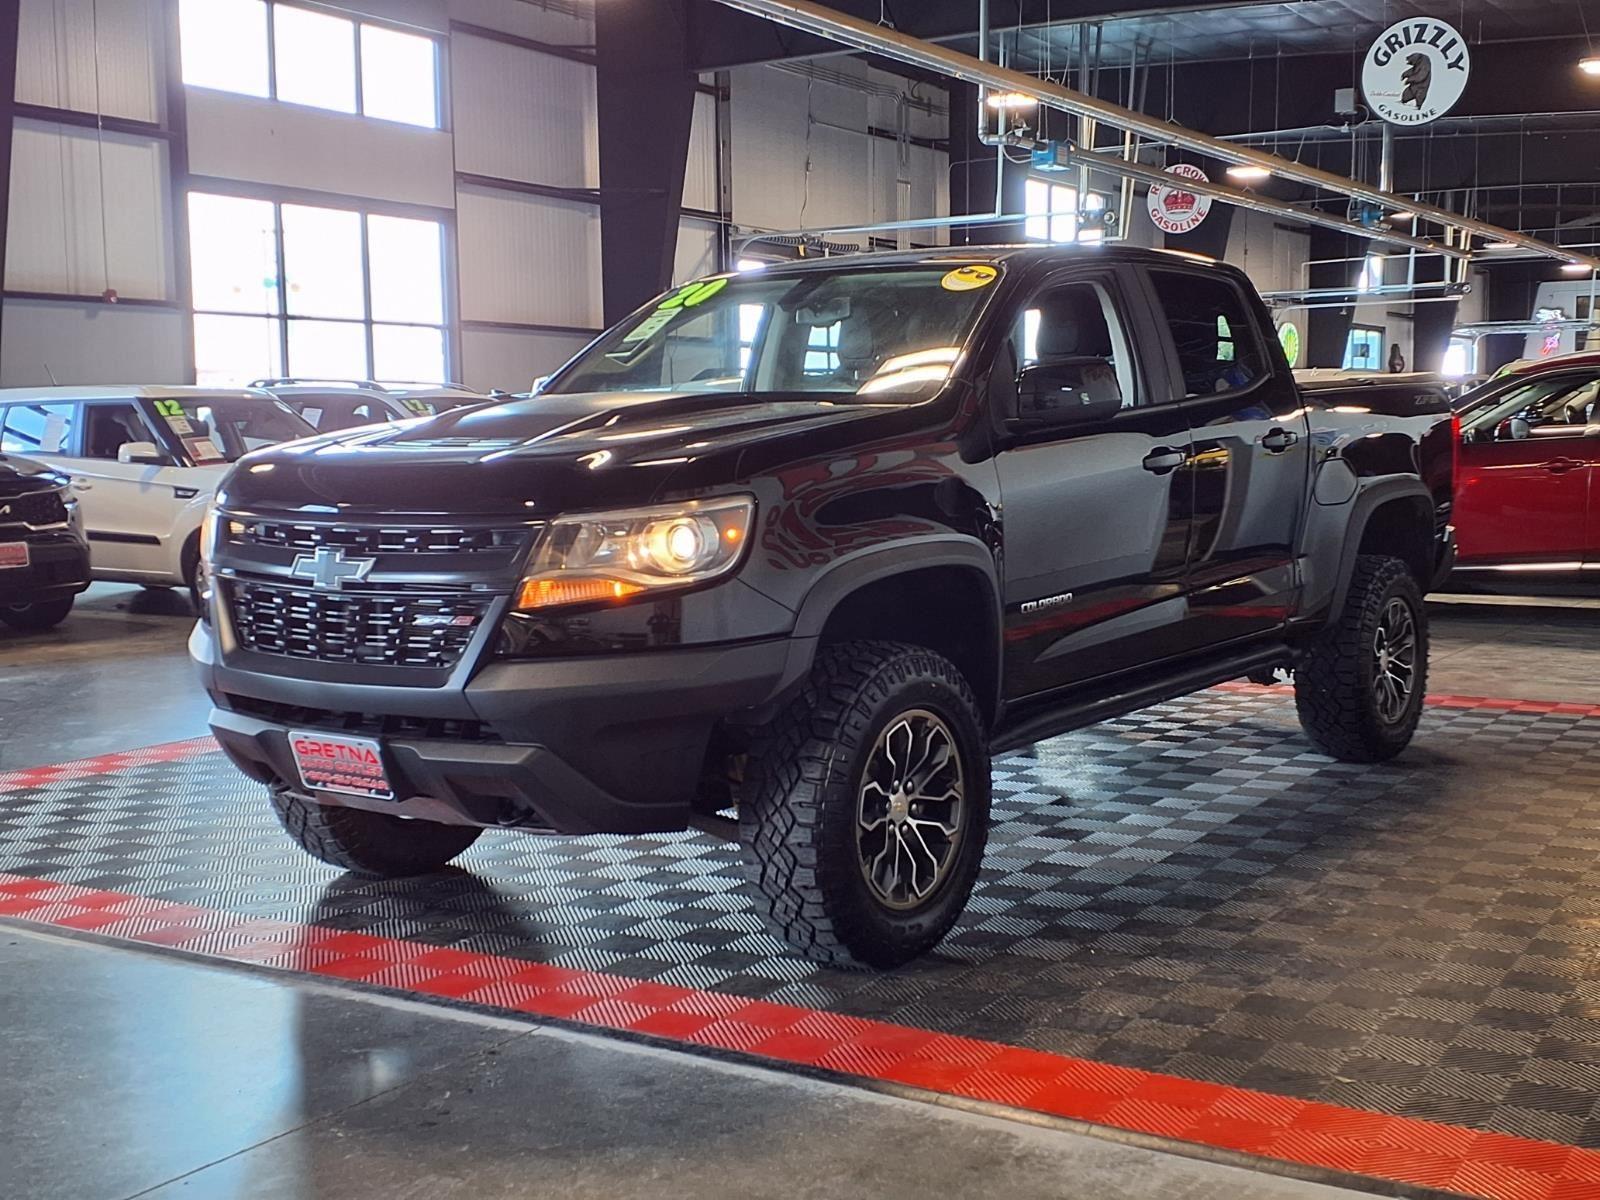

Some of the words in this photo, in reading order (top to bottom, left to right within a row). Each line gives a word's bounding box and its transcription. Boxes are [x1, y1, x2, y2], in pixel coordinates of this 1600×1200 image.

[1373, 23, 1465, 72] GRIZZLY
[1378, 104, 1437, 121] GASOLINE
[1151, 207, 1207, 231] GASOLINE
[153, 399, 185, 416] 12
[1021, 592, 1073, 613] COLORADO
[294, 739, 379, 765] GRETNA
